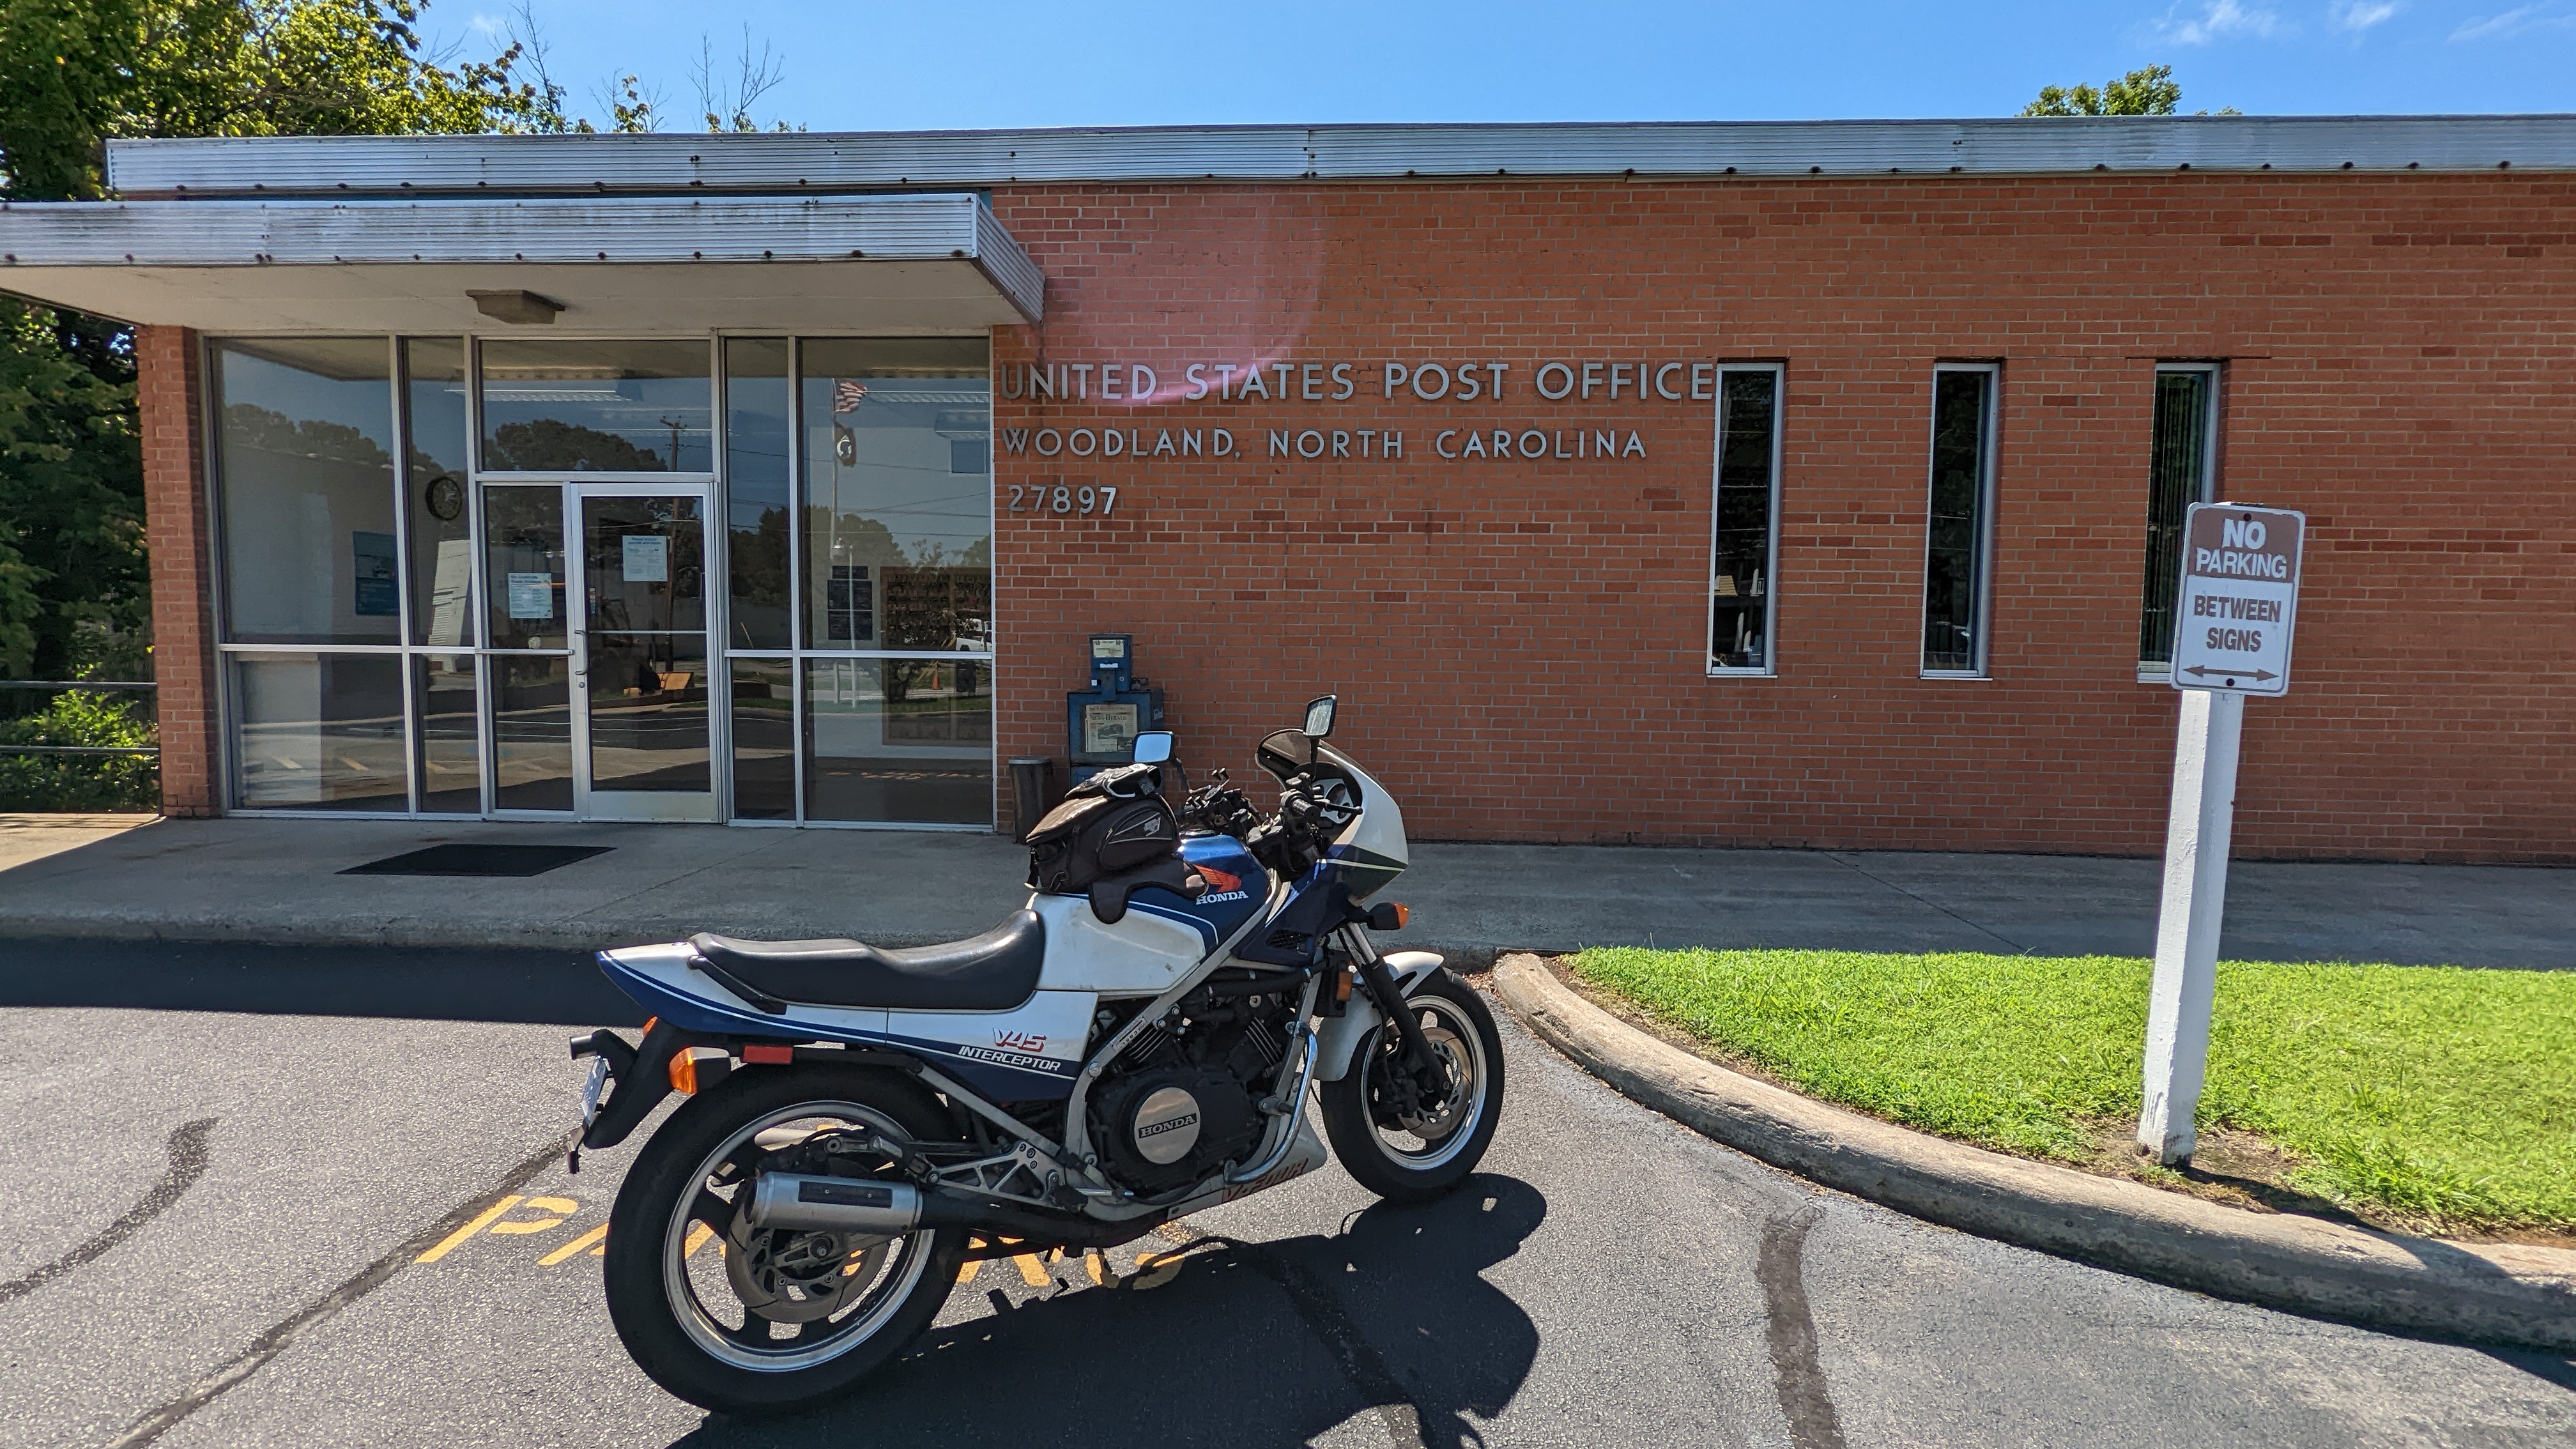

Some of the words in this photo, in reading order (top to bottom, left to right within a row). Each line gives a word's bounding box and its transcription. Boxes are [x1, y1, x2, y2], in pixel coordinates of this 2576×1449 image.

[1001, 364, 1156, 401] UNITED
[1184, 363, 1354, 401] STATES
[1385, 362, 1509, 401] POST
[1536, 362, 1713, 401] OFFICE
[1002, 428, 1241, 459] WOODLAND,
[1269, 429, 1403, 459] NORTH
[1436, 429, 1647, 459] CAROLINA
[1008, 484, 1117, 514] 27897
[2221, 518, 2266, 549] NO
[2195, 547, 2287, 579] PARKING
[2194, 595, 2282, 623] BETWEEN
[2206, 627, 2262, 652] SIGNS
[1196, 891, 1249, 905] HONDA
[992, 1027, 1047, 1053] V45
[958, 1045, 1061, 1071] INTERCEPTOR
[1140, 1115, 1195, 1137] HONDA
